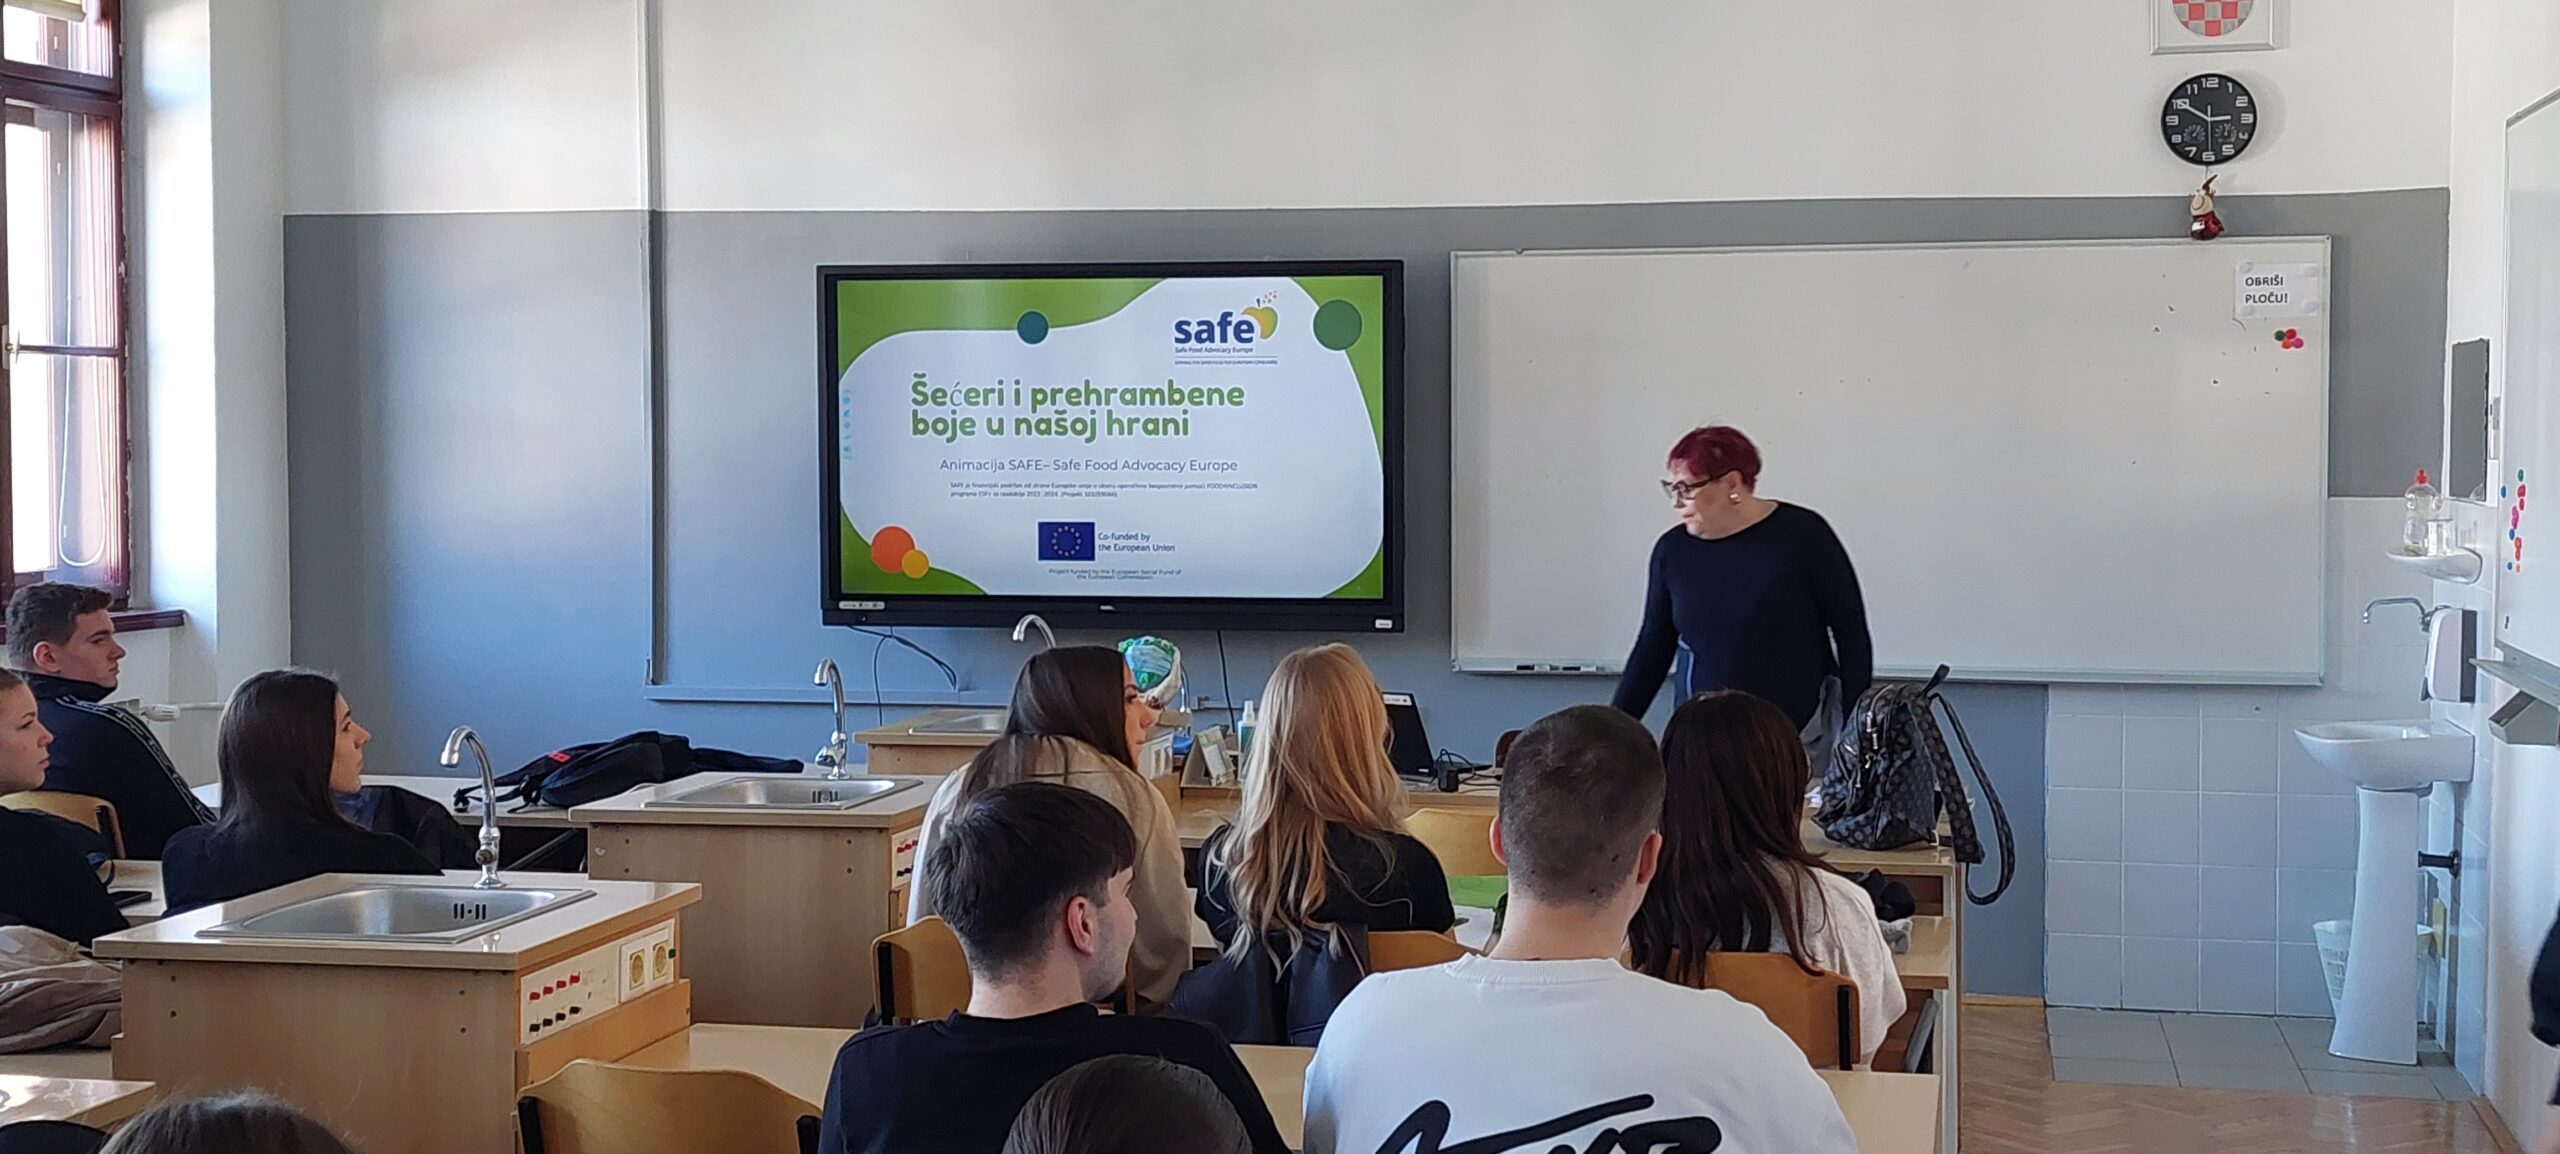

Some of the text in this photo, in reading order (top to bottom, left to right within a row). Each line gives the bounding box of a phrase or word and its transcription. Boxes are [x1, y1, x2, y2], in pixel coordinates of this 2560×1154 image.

[2201, 77, 2219, 88] 12
[2227, 82, 2233, 93] 1
[2186, 84, 2198, 95] 11
[2171, 99, 2190, 110] 10
[2235, 96, 2249, 107] 2
[2165, 115, 2179, 126] 9
[2240, 113, 2254, 124] 3
[2171, 134, 2182, 143] 8
[2184, 147, 2197, 158] 7
[2222, 144, 2235, 156] 5
[2202, 151, 2216, 162] 6
[2245, 274, 2284, 287] OBRIŠI
[2245, 291, 2288, 304] PLOČU!
[1174, 311, 1255, 344] safe
[911, 372, 1245, 414] Šećeri i prehrambene
[912, 409, 1189, 443] boje u našoj hrani
[940, 459, 1005, 473] Animacija
[1053, 459, 1082, 471] Safe
[1085, 459, 1118, 471] Food
[1122, 459, 1186, 473] Advocacy
[1190, 460, 1238, 473] Europe
[1098, 533, 1150, 542] Co-funded by
[1098, 544, 1175, 553] the European Union
